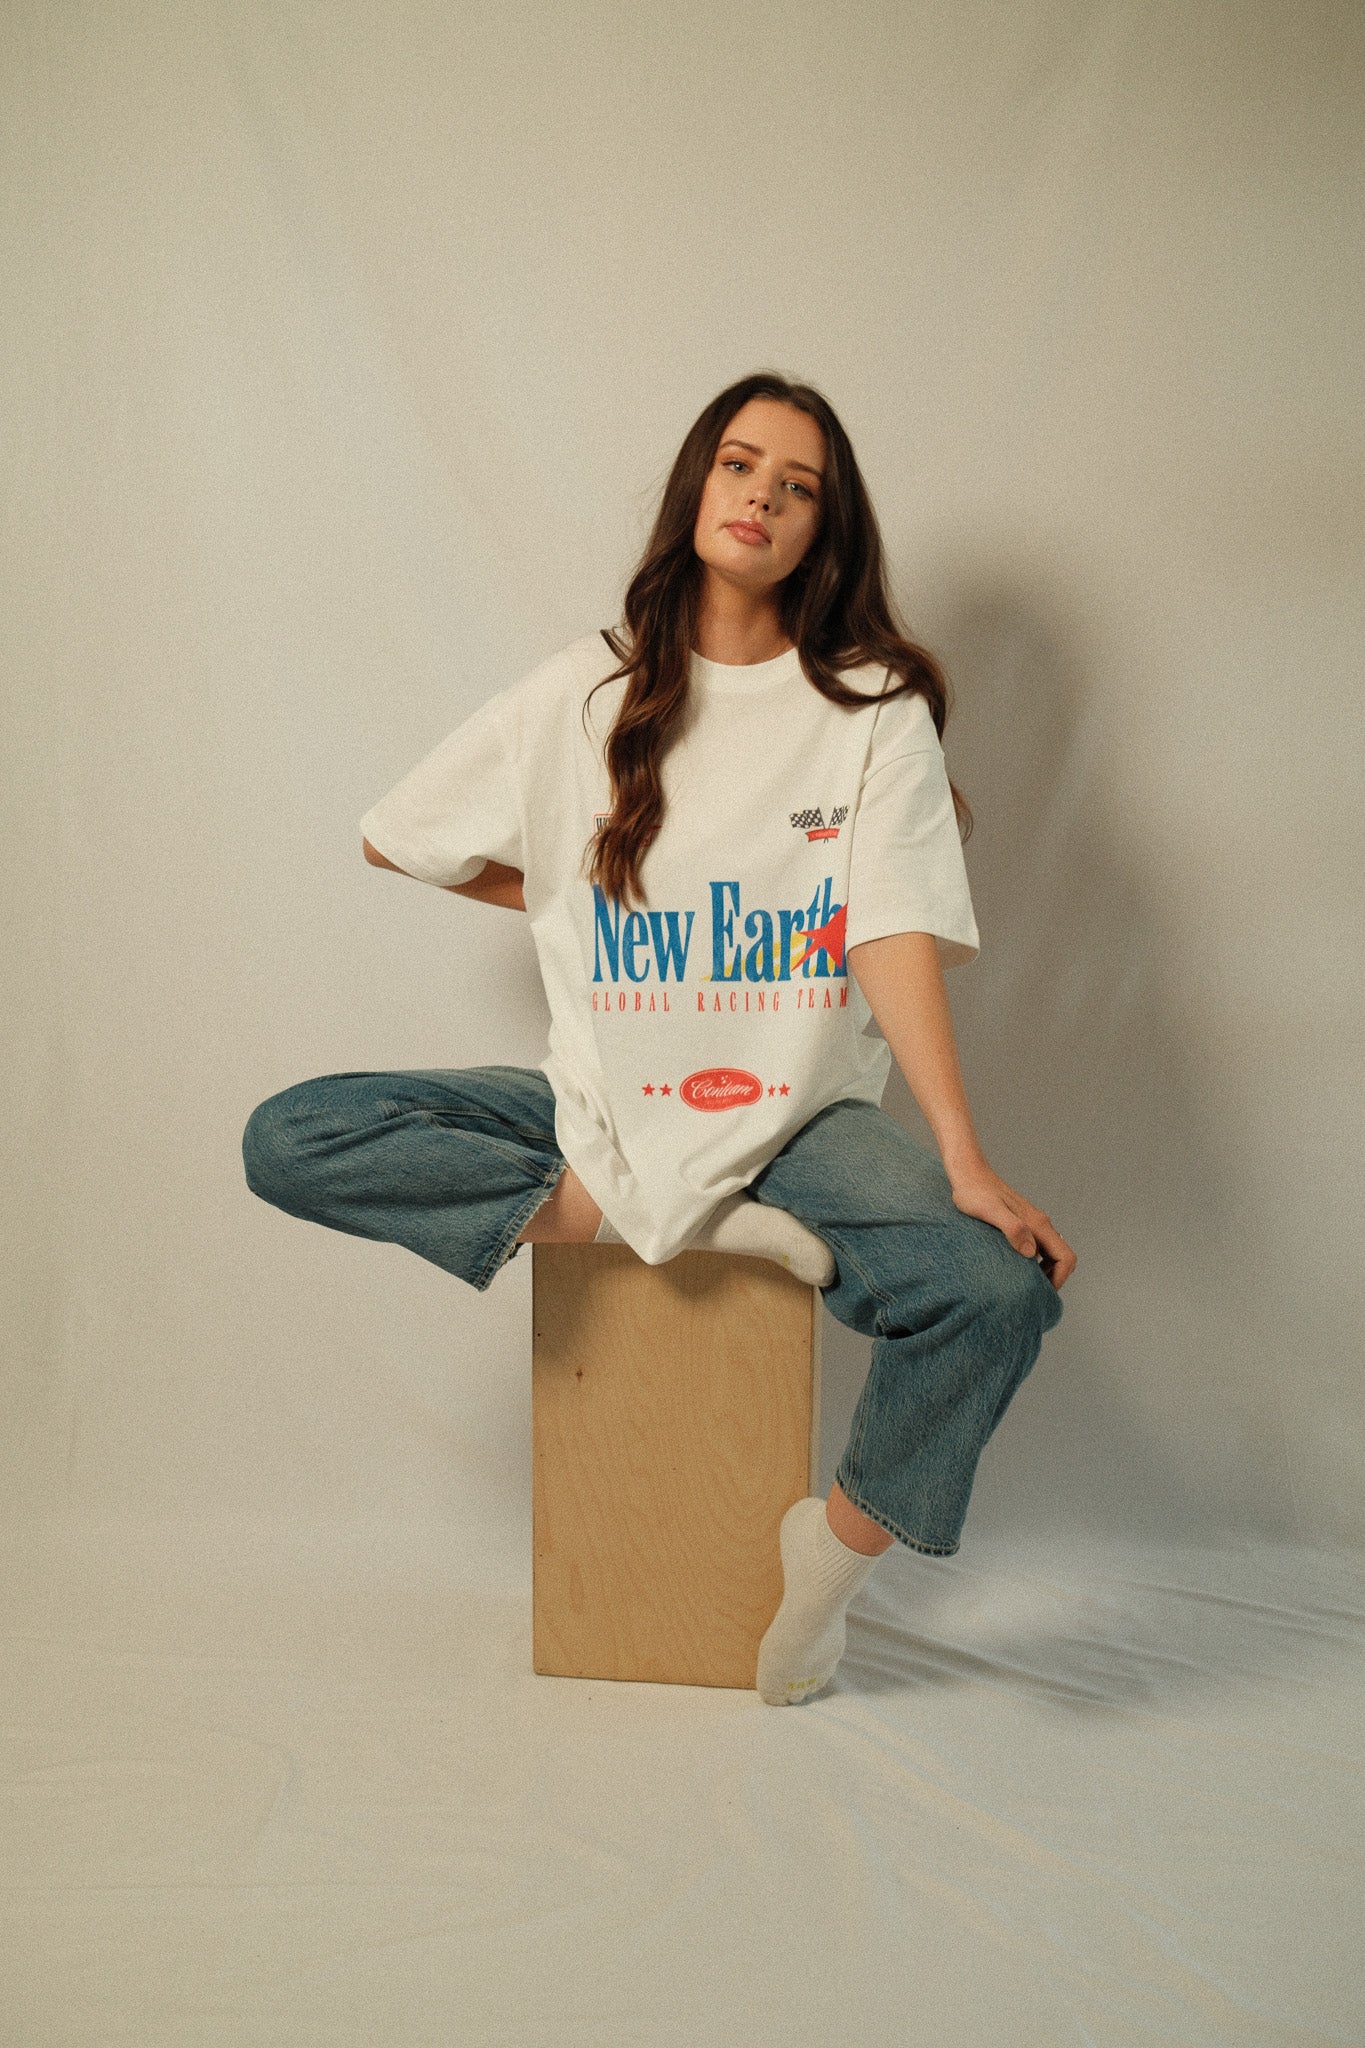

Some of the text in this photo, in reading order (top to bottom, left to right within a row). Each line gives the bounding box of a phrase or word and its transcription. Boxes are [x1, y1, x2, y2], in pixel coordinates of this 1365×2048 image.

[592, 883, 696, 983] New
[592, 986, 848, 1012] GLOBAL RACING TEAM
